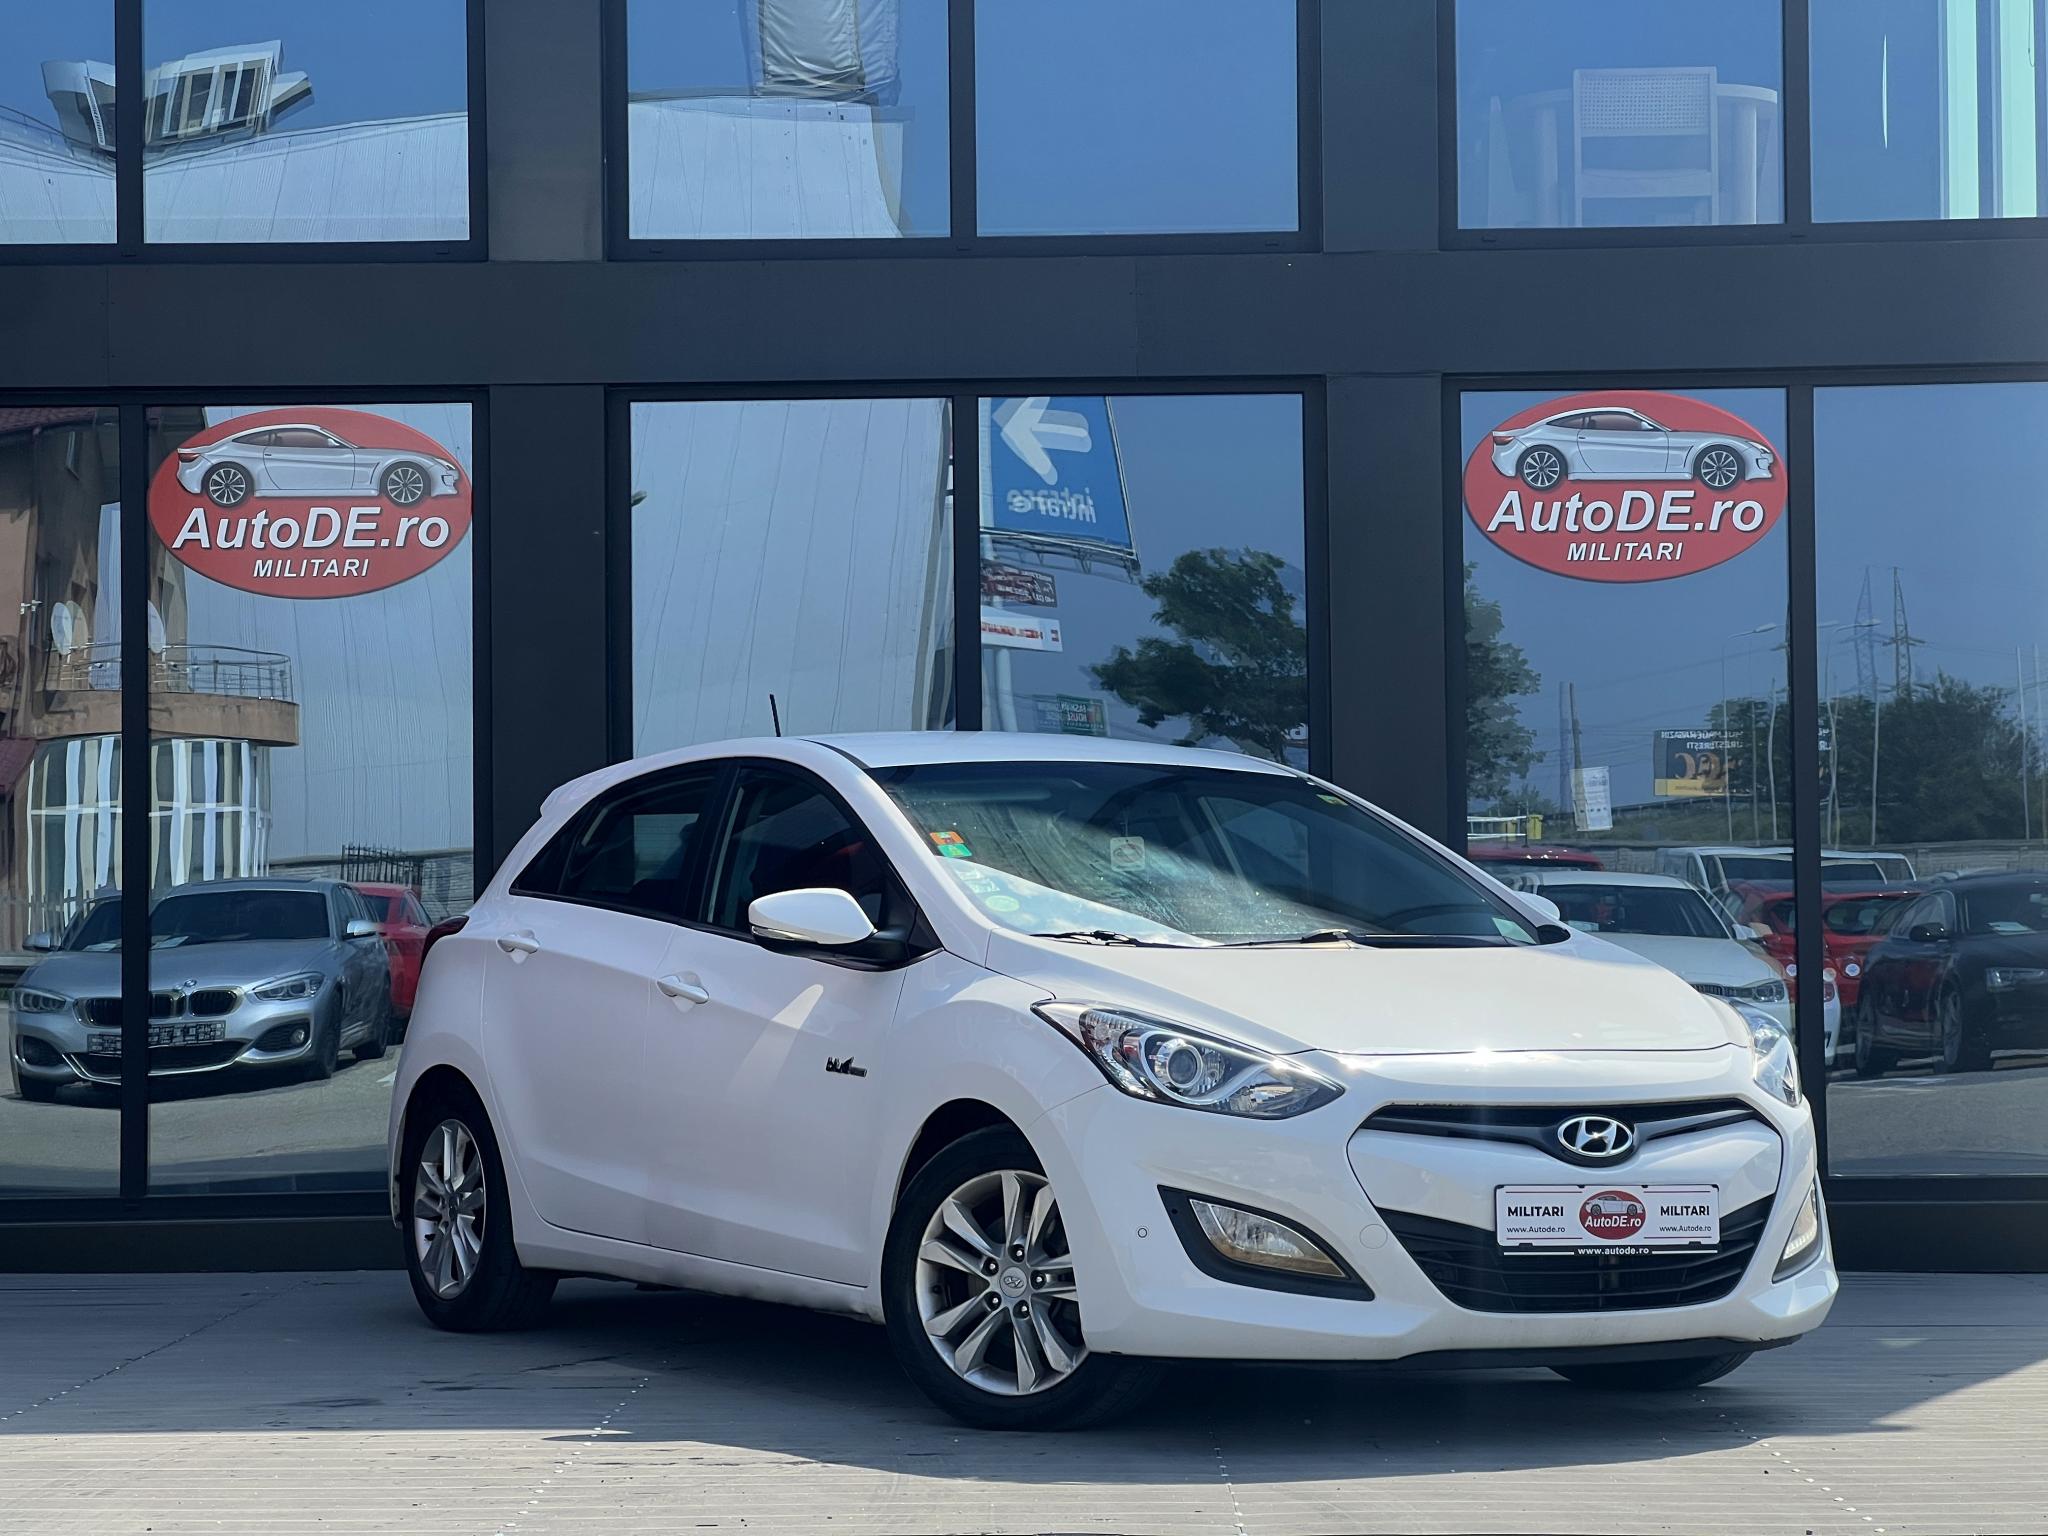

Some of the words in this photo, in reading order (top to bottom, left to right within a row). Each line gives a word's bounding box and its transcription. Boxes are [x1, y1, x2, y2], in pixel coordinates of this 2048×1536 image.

[1487, 490, 1764, 532] AutoDE.ro
[171, 506, 450, 549] AutoDE.ro
[1566, 542, 1683, 561] MILITARI
[253, 558, 369, 577] MILITARI
[1507, 1206, 1564, 1217] MILITARI
[1660, 1205, 1710, 1216] MILITARI
[1584, 1215, 1642, 1228] AutoDE.ro
[1506, 1225, 1566, 1234] www.Autode.ro
[1659, 1225, 1712, 1233] www.Autode.ro
[1578, 1246, 1650, 1255] www.autode.ro
